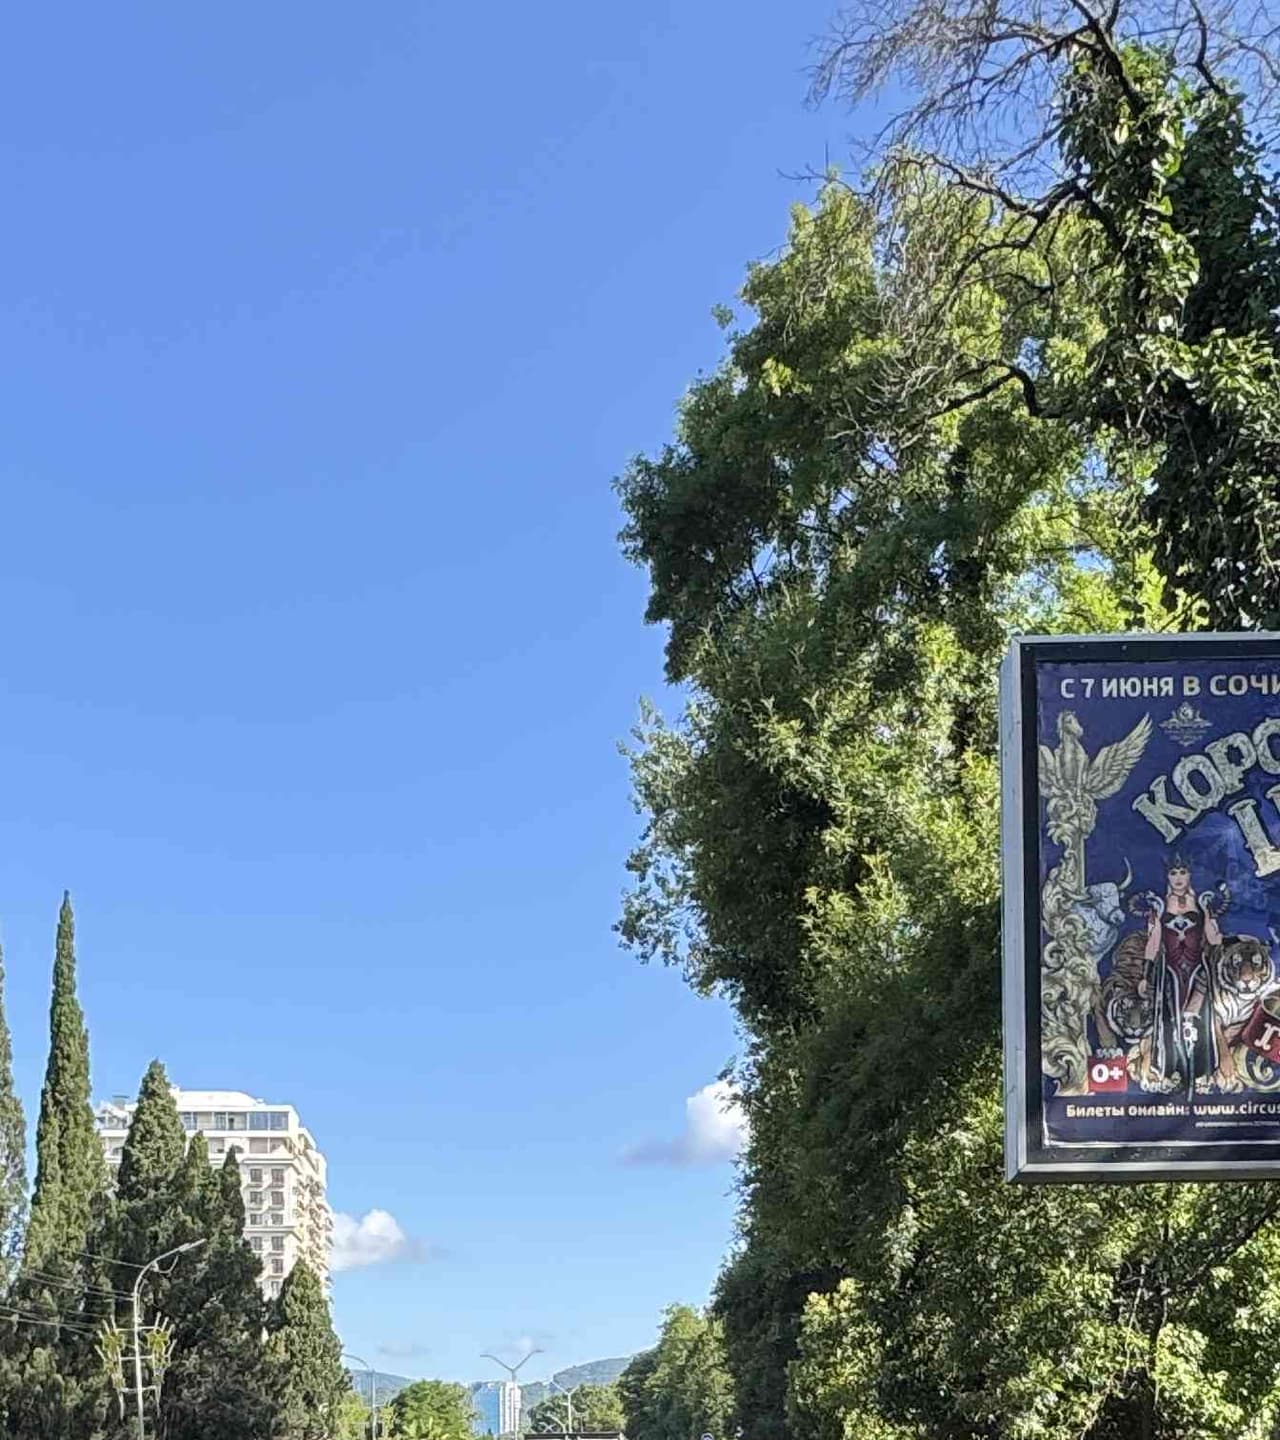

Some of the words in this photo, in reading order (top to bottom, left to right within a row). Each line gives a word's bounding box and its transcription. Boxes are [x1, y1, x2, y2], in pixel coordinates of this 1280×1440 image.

[1060, 678, 1075, 699] С
[1081, 678, 1096, 699] 7
[1102, 677, 1174, 698] ИЮНЯ
[1183, 676, 1201, 697] В
[1091, 1063, 1124, 1084] 0+
[1066, 1103, 1124, 1118] Билеты
[1128, 1102, 1190, 1117] онлайн:
